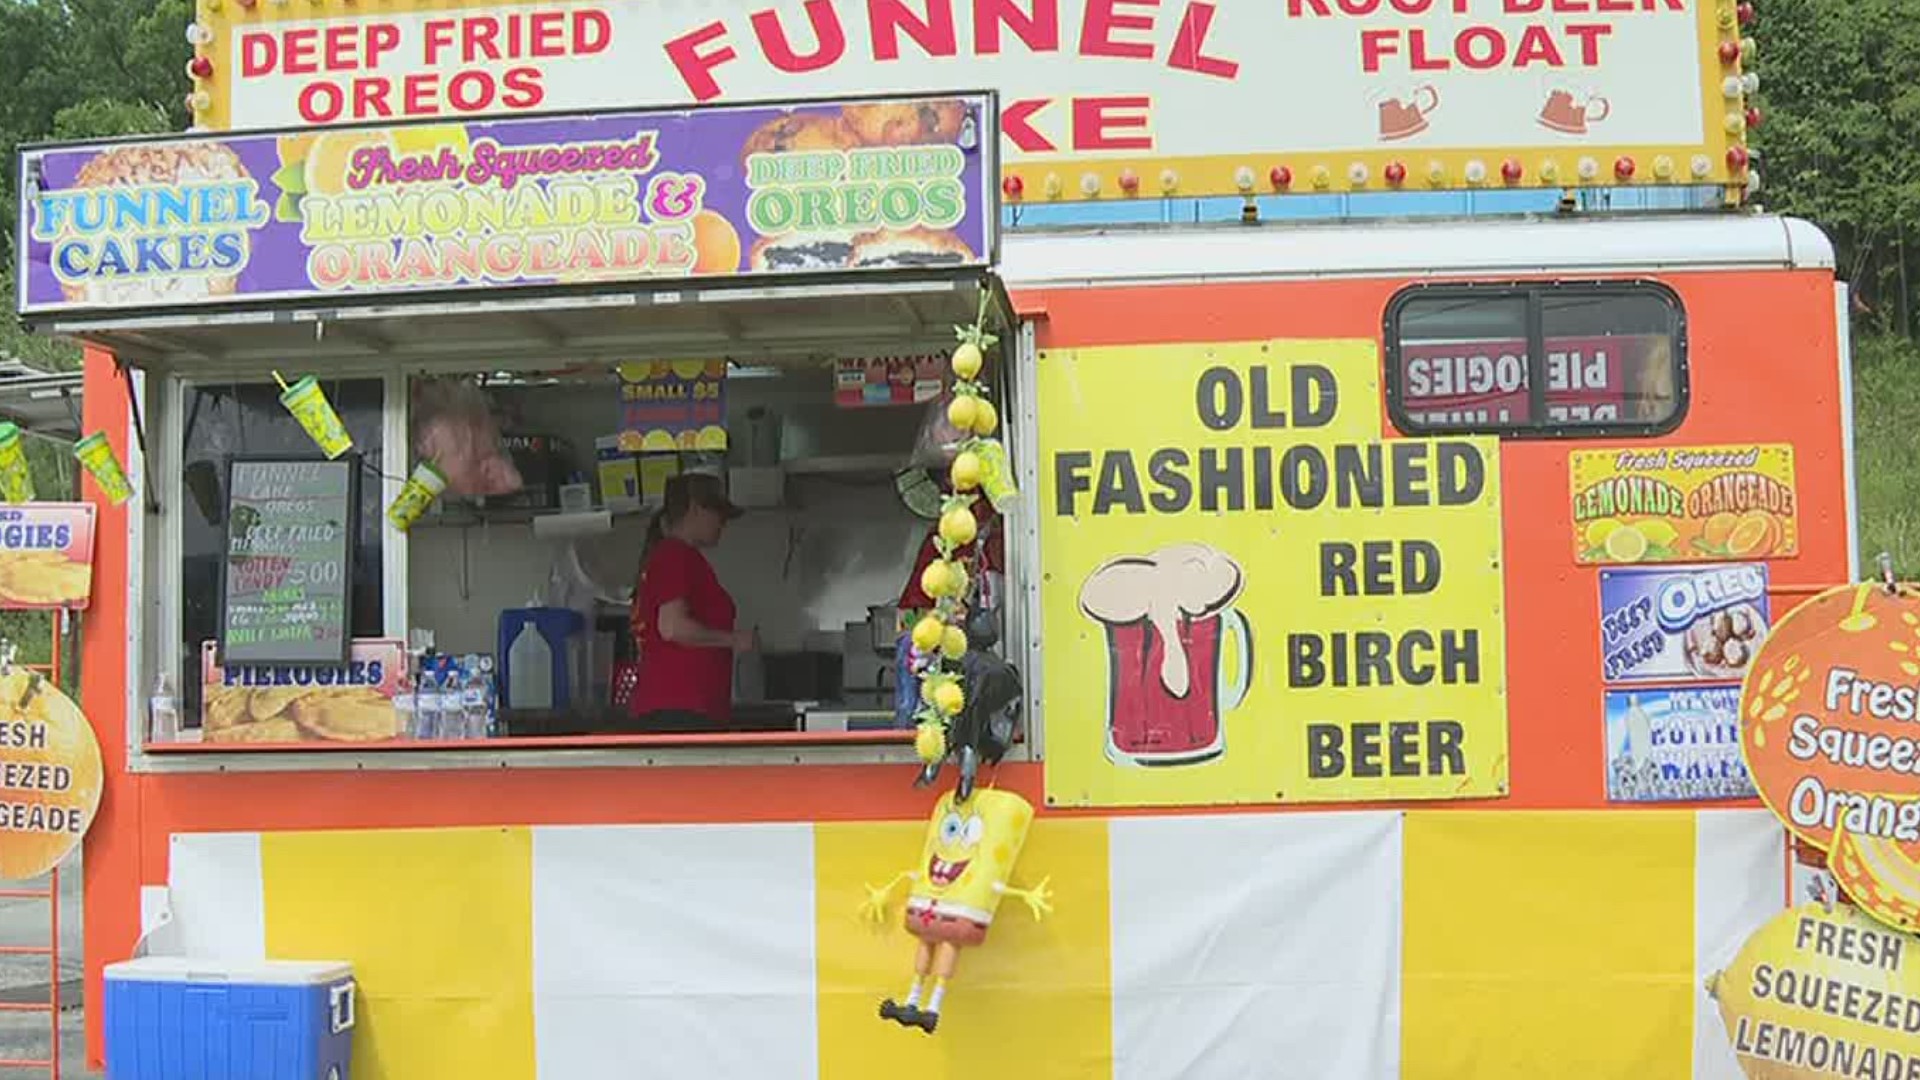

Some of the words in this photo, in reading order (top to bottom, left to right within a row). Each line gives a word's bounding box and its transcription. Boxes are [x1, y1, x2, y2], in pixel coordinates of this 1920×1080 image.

[241, 24, 402, 78] DEEP
[423, 9, 612, 65] FRIED
[664, 0, 1239, 101] FUNNEL
[1360, 24, 1613, 73] FLOAT
[300, 66, 546, 123] OREOS
[1001, 96, 1154, 152] KE
[348, 146, 463, 190] Fresh
[465, 134, 656, 188] Squeezed
[752, 151, 844, 185] DEEP
[850, 148, 959, 182] FRIED
[37, 184, 267, 236] FUNNEL
[304, 178, 637, 241] LEMONADE
[653, 177, 698, 218] &
[755, 183, 963, 227] OREOS
[56, 230, 242, 278] CAKES
[312, 225, 692, 283] ORANGEADE
[622, 383, 687, 401] SMALL
[1195, 363, 1340, 432] OLD
[1407, 351, 1608, 396] PIEOGIES
[1053, 441, 1486, 517] FASHIONED
[1615, 450, 1667, 471] Fresh
[1671, 447, 1759, 472] Squeezed
[1574, 475, 1685, 522] LEMONADE
[1688, 471, 1796, 518] ORANGEADE
[0, 525, 70, 549] GIES
[1319, 540, 1442, 597] RED
[1604, 595, 1651, 642] DEEP
[1657, 569, 1764, 629] OREO
[1286, 630, 1480, 689] BIRCH
[1605, 629, 1666, 678] FRIED
[0, 722, 46, 749] ESH
[1306, 720, 1466, 779] BEER
[3, 763, 71, 791] EZED
[0, 802, 81, 833] GEADE
[1787, 774, 1920, 843] Orang
[1796, 917, 1903, 971] FRESH
[1752, 963, 1920, 1033] SQUEEZED
